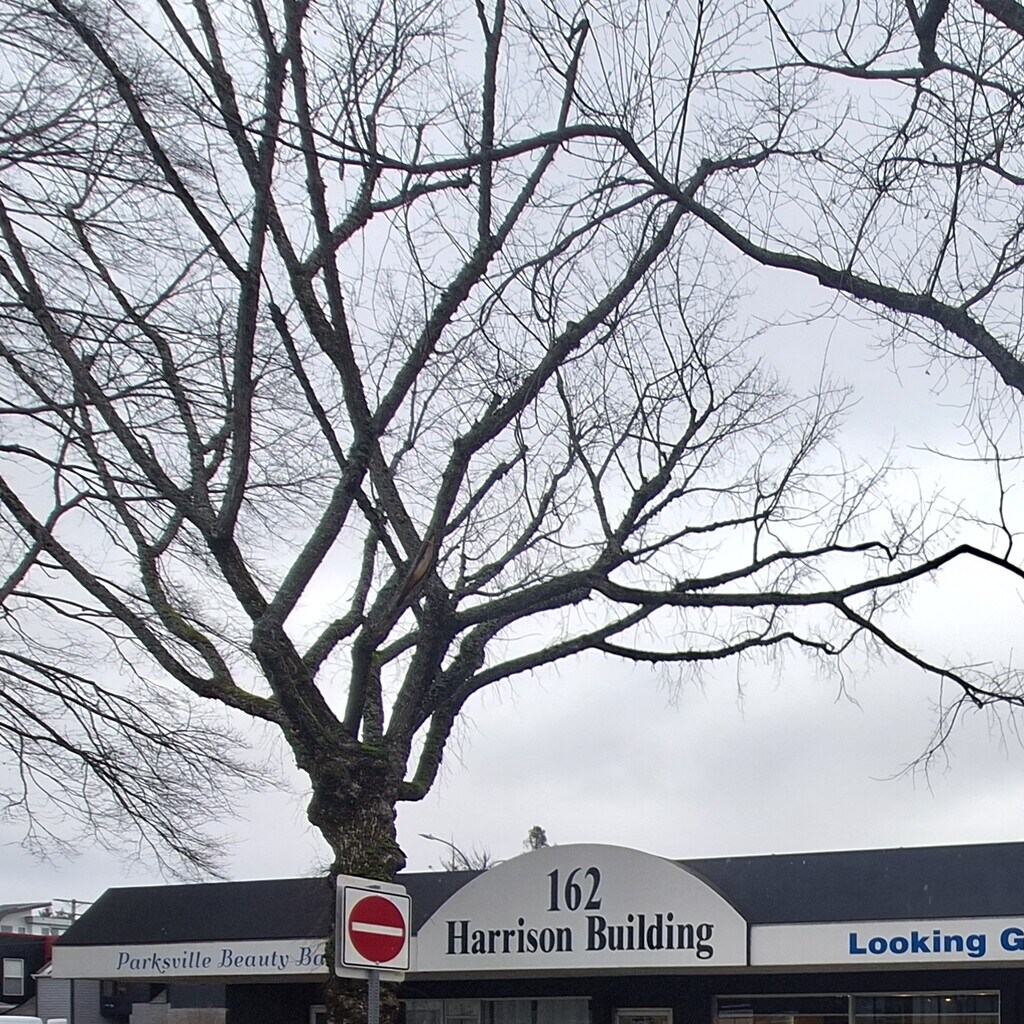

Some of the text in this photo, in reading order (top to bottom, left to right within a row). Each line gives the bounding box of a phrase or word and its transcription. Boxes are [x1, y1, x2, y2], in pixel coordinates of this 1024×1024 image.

[547, 866, 602, 912] 162
[445, 911, 714, 960] Harrison Building
[849, 930, 986, 958] Looking
[116, 946, 325, 974] Parksville Beauty Ba
